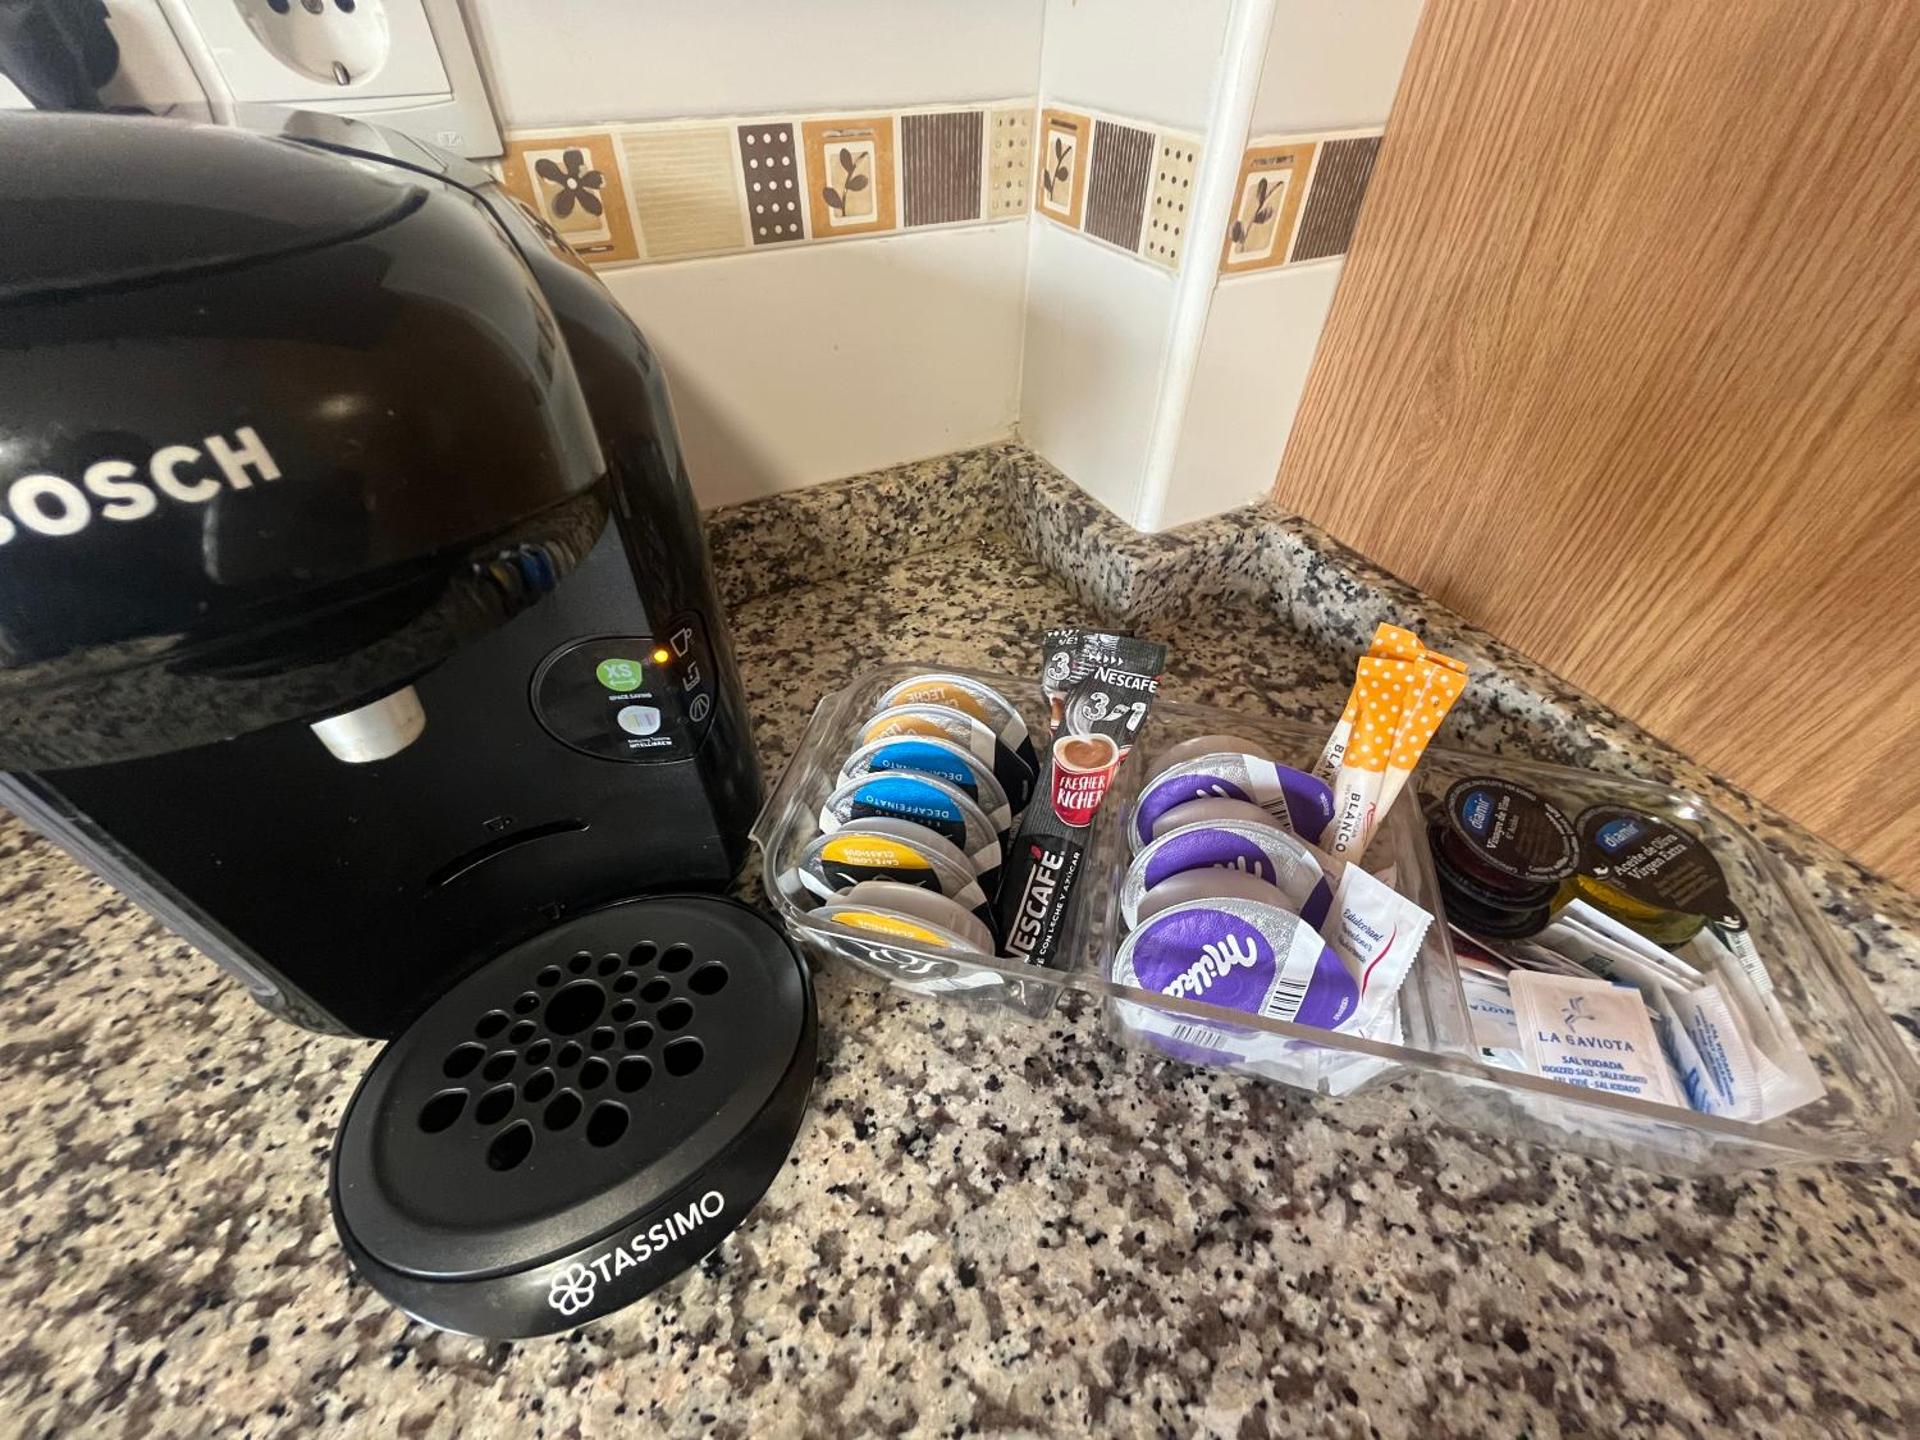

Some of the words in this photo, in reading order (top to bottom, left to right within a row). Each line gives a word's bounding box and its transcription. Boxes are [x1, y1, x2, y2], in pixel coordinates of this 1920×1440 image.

[603, 664, 632, 678] XS
[1083, 692, 1110, 721] 3
[1060, 776, 1106, 790] FRESHER
[866, 795, 950, 819] DECAFFEINATO
[1057, 788, 1104, 809] RICHER
[1335, 793, 1361, 853] BLANCO
[1614, 852, 1647, 876] Aceite
[1651, 834, 1679, 852] Oliva
[1627, 857, 1666, 880] Virgen
[1039, 935, 1053, 956] CON
[1048, 903, 1064, 933] LECHE
[1162, 933, 1258, 998] Milka
[1538, 1031, 1561, 1044] LA
[1565, 1034, 1635, 1053] GAVIOTA
[590, 1191, 724, 1282] TASSIMO
